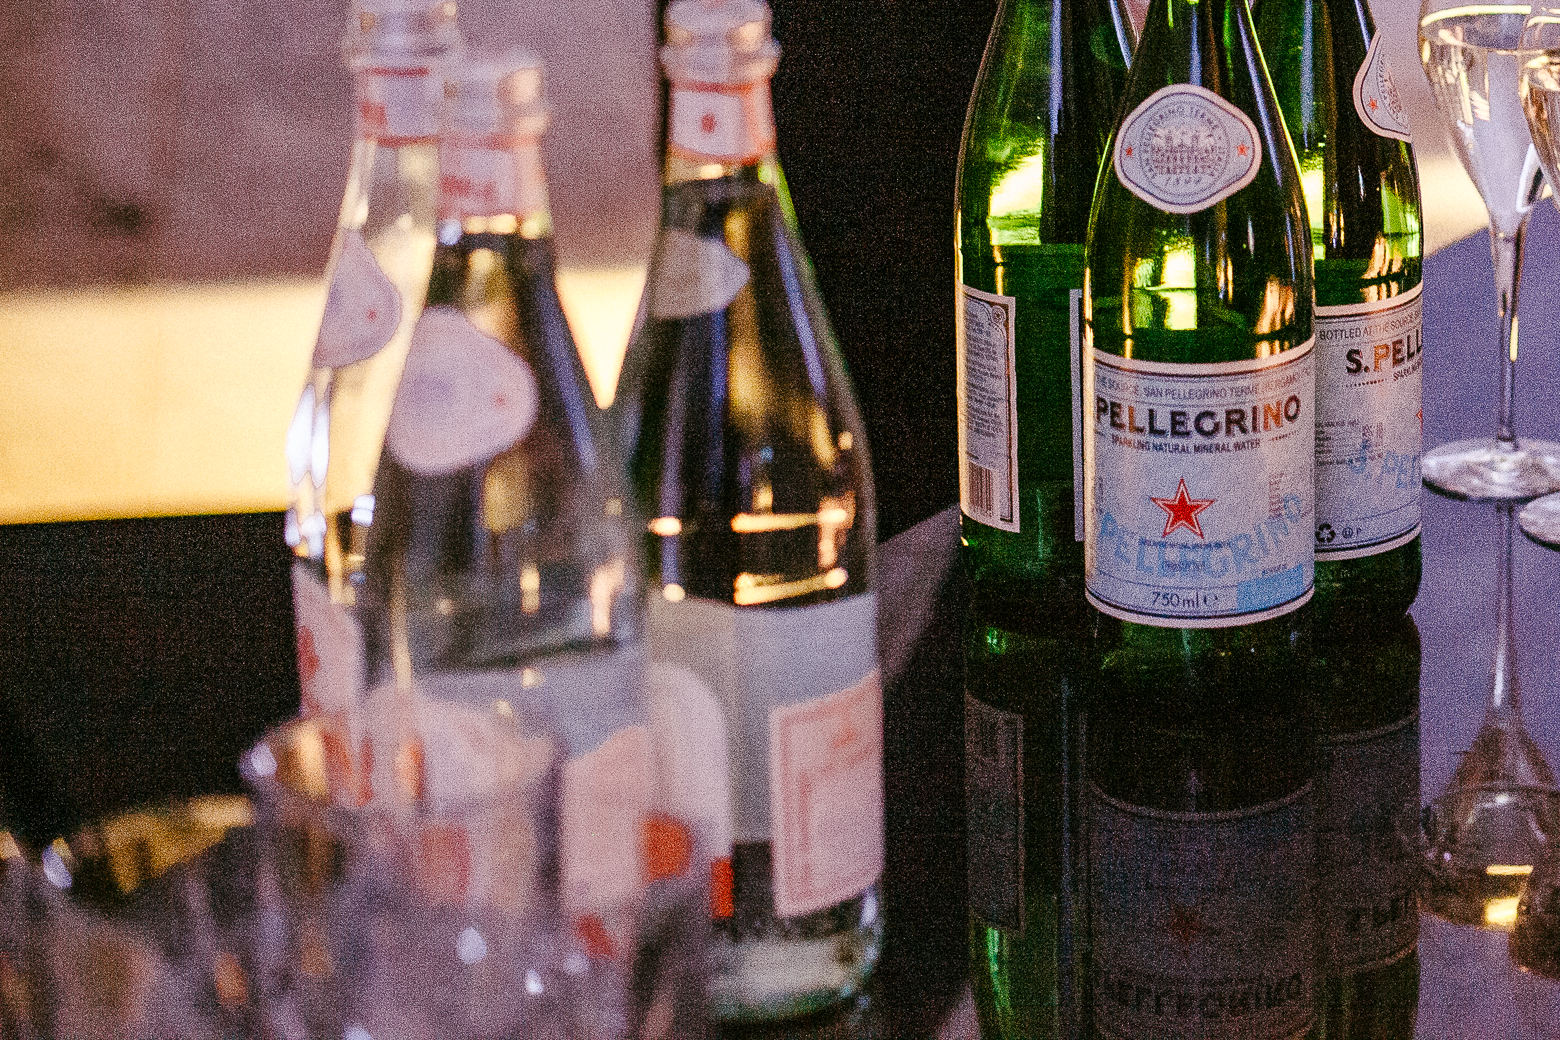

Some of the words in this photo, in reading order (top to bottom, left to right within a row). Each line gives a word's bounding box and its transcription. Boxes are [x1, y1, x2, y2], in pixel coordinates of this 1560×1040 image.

[1319, 327, 1362, 341] BOTTLED
[1164, 387, 1228, 400] PELLEGRINO
[1096, 394, 1301, 437] PELLEGRINO
[1152, 441, 1191, 454] NATURAL
[1193, 441, 1231, 454] MINERAL
[1233, 438, 1261, 452] WATER
